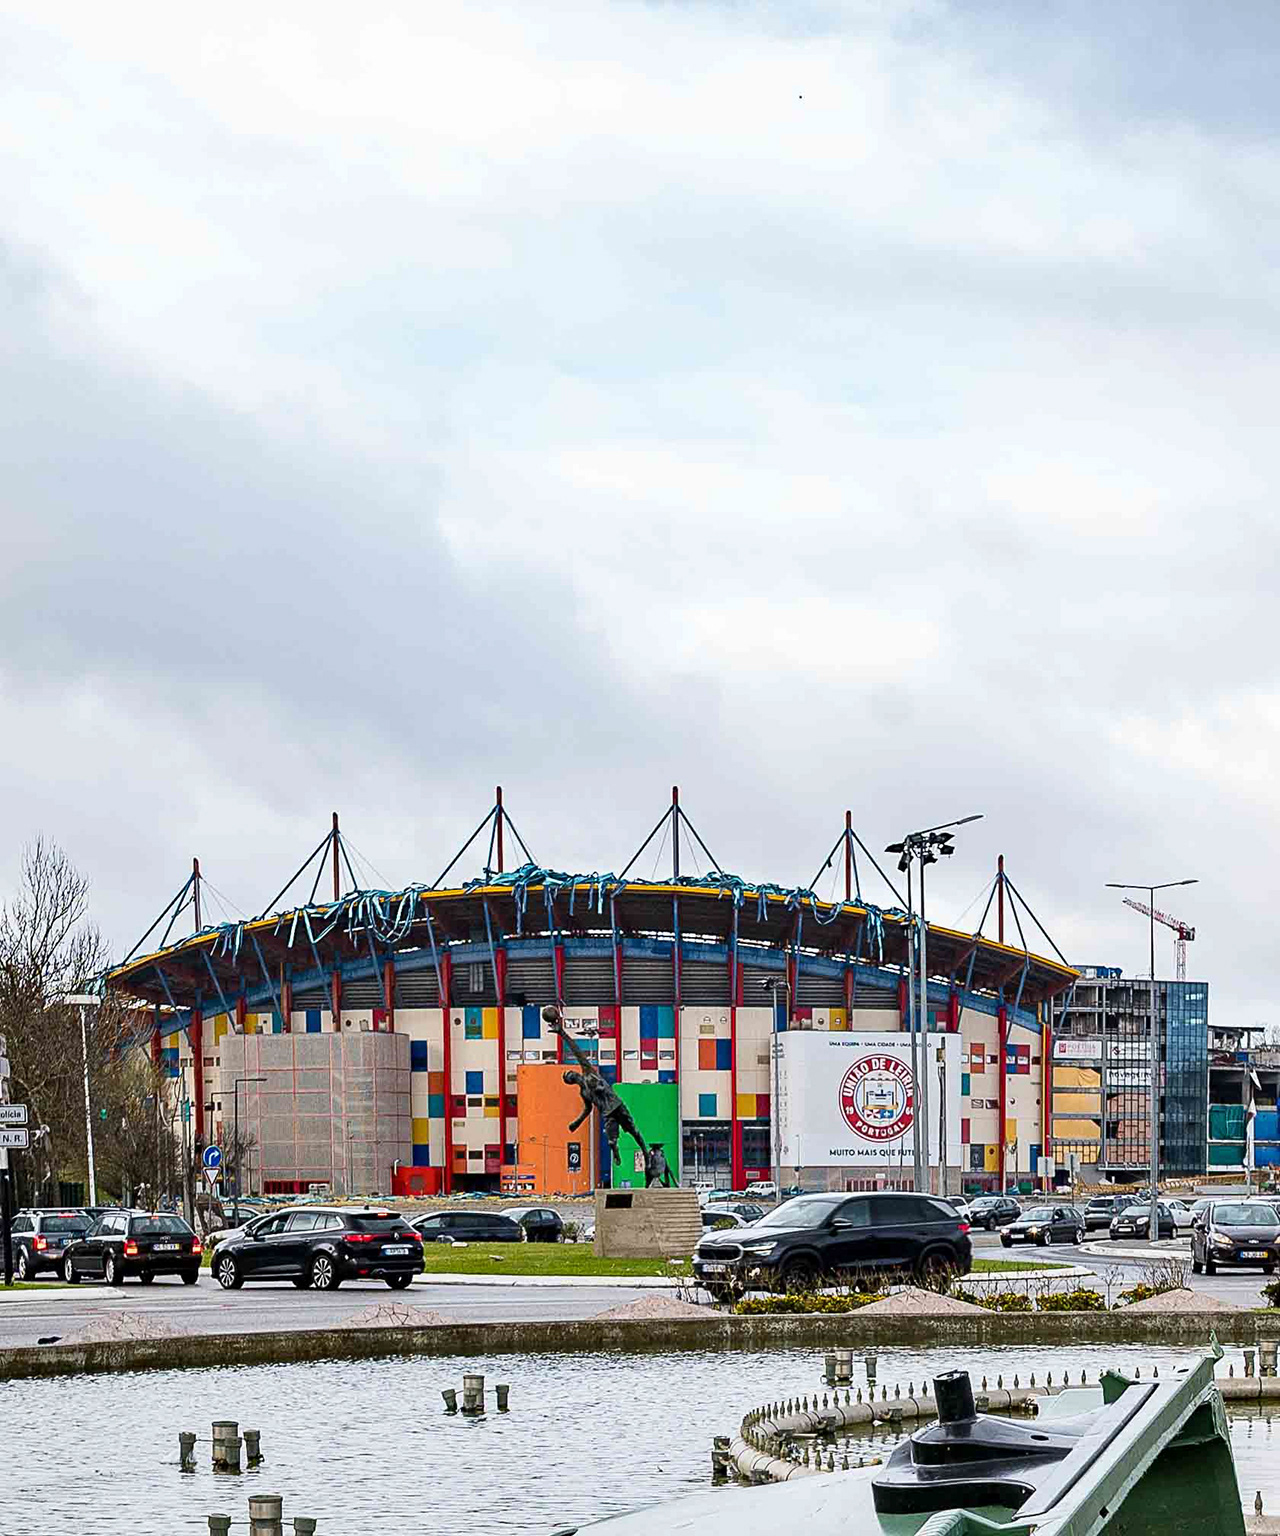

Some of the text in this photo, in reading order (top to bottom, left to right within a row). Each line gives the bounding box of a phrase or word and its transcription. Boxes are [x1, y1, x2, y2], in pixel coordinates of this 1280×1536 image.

[871, 1058, 887, 1070] DE
[845, 1106, 854, 1115] 19
[855, 1120, 905, 1137] PORTUGAL
[829, 1149, 856, 1157] MUITO
[857, 1149, 878, 1157] MAIS
[879, 1149, 896, 1157] QUE
